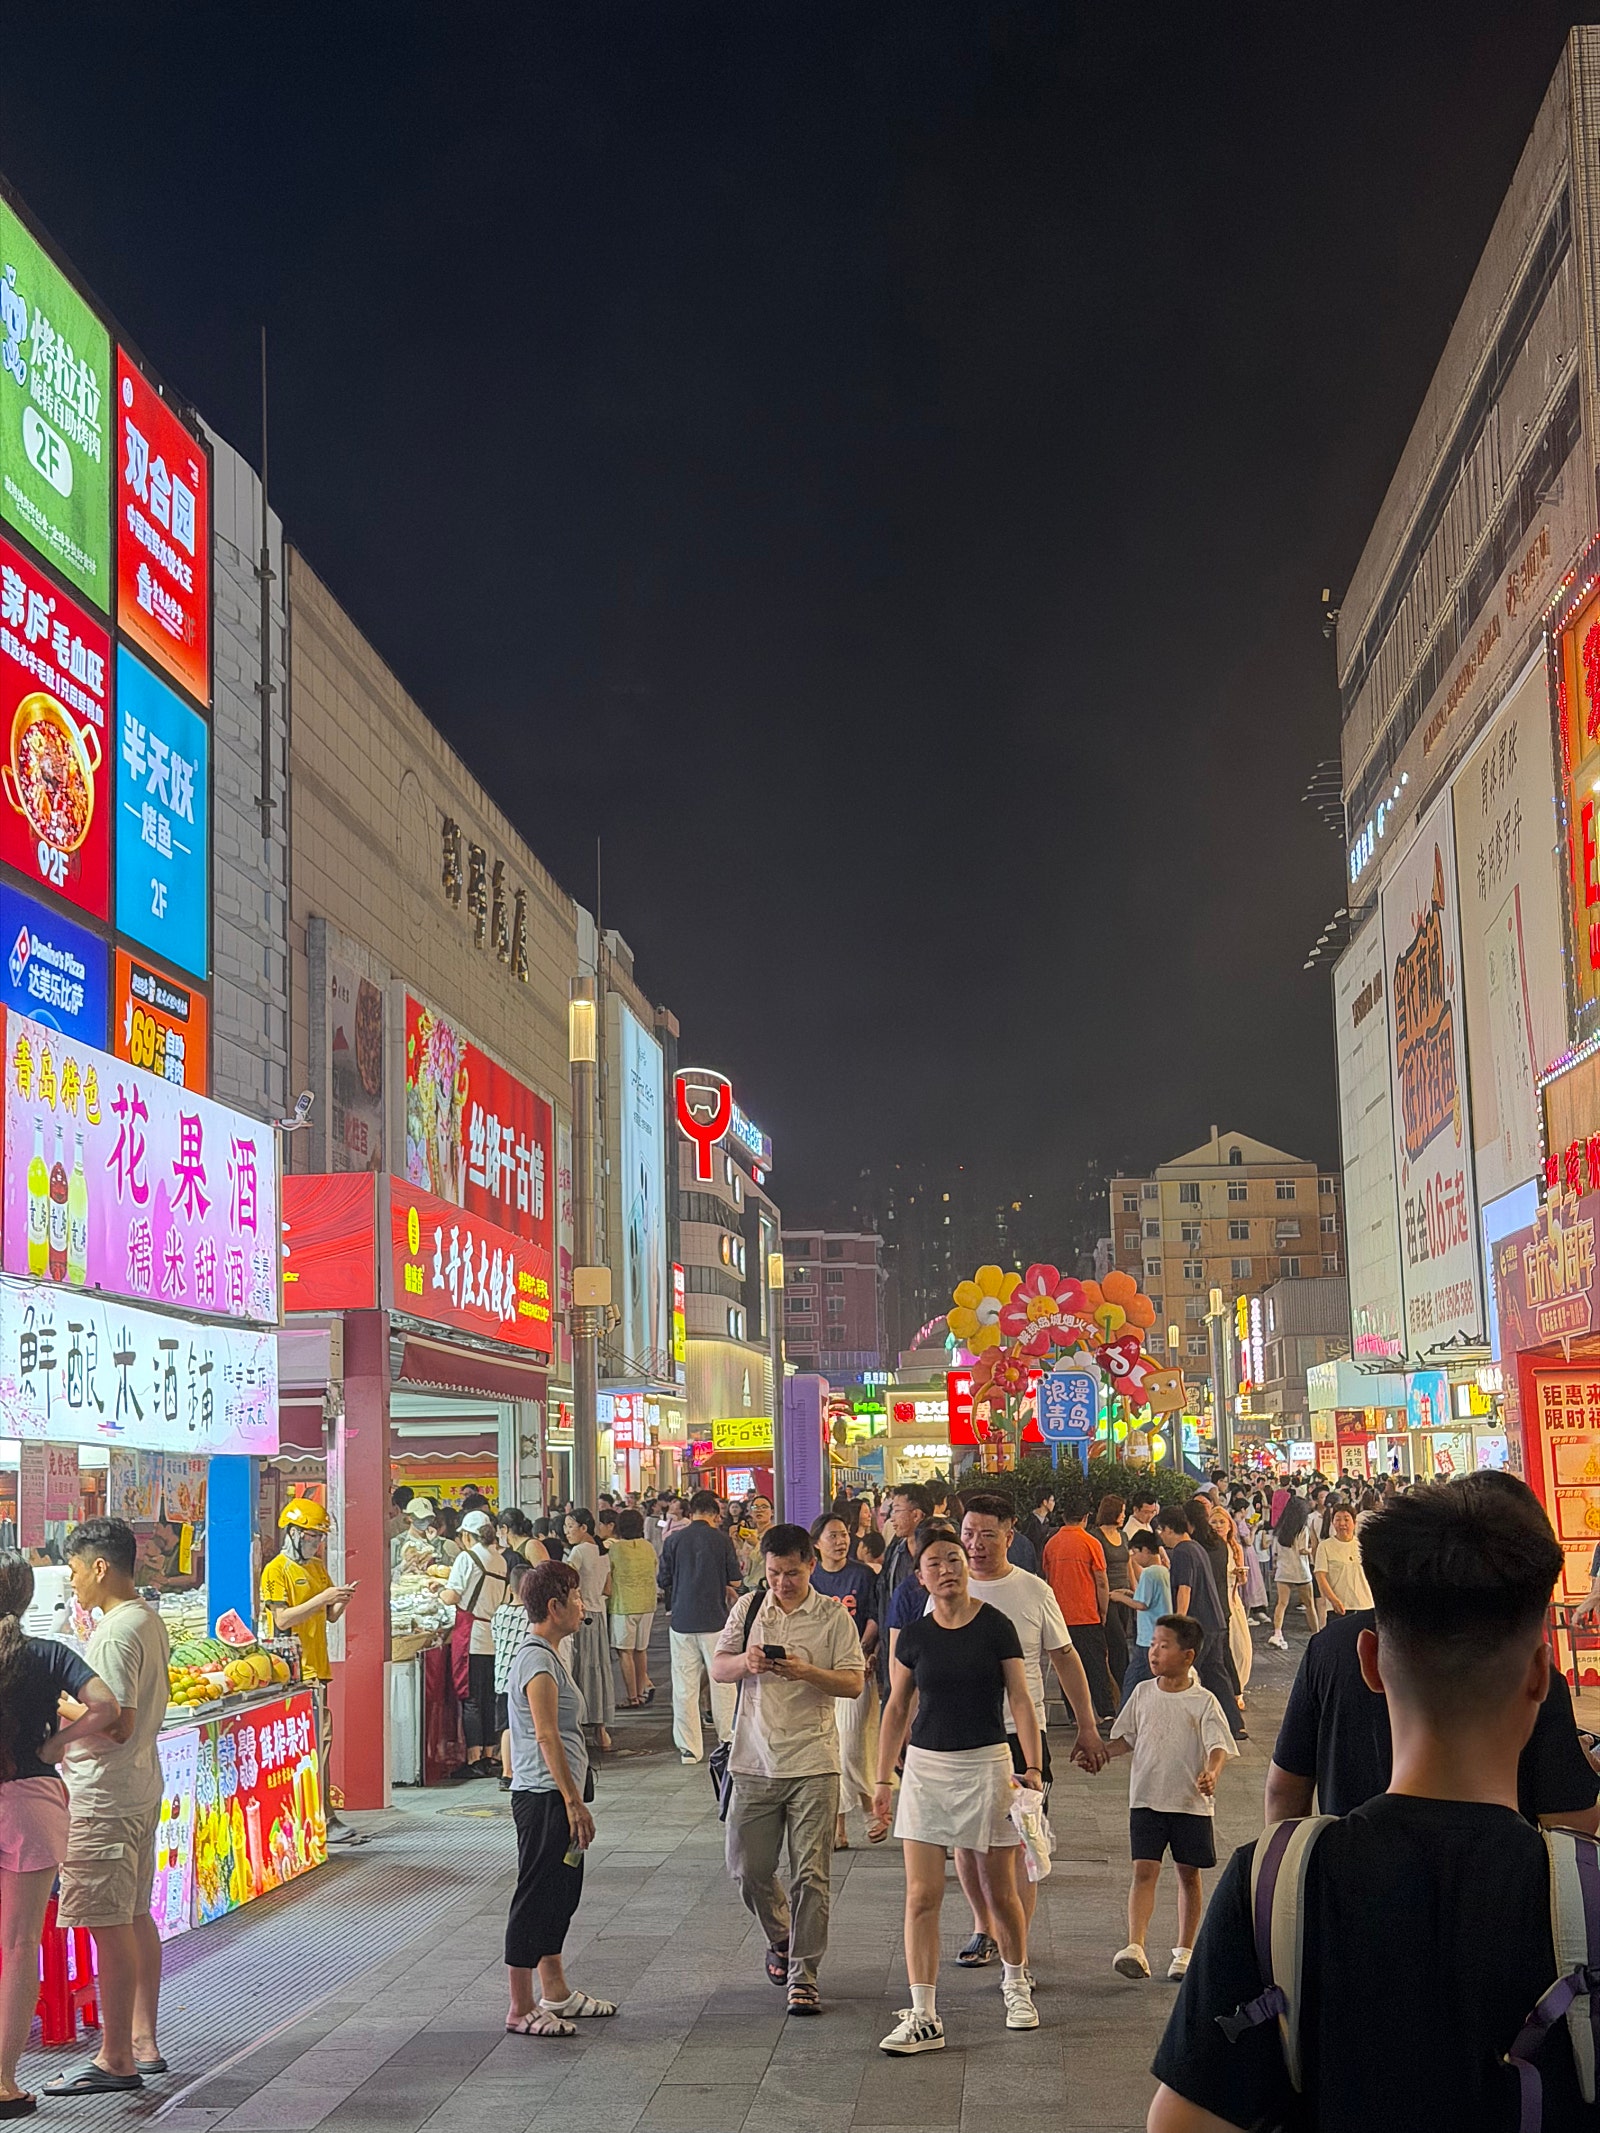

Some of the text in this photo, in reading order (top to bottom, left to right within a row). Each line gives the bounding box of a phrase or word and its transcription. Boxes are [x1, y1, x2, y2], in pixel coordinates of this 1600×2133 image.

[30, 306, 102, 432] 烤拉拉
[30, 367, 101, 463] 旋转自助烤肉
[34, 419, 60, 479] 2F
[125, 416, 195, 556] 双合园
[1, 565, 105, 698] 茅庐 毛血旺
[122, 711, 195, 825] 半天妖
[49, 848, 69, 887] 2F
[141, 801, 173, 859] 烤鱼
[151, 878, 168, 919] 2F
[28, 963, 84, 1016] 达美乐比萨
[31, 934, 85, 980] Domino's Pizza
[1395, 928, 1443, 1042] 当代商城
[13, 1032, 101, 1126] 青岛特色
[131, 1006, 157, 1068] 69
[1403, 1025, 1454, 1141] 低价招租
[106, 1082, 259, 1240] 花果酒
[469, 1101, 544, 1221] 丝路千古情
[126, 1216, 245, 1315] 糯米甜酒
[1405, 1169, 1469, 1268] 租金0.6元起
[432, 1225, 516, 1322] 王哥庄大馒头
[20, 1305, 214, 1433] 鲜酿米酒铺
[1017, 1313, 1099, 1346] 解锁岛城烟火气
[1045, 1379, 1090, 1405] 浪漫
[1045, 1403, 1090, 1432] 青岛
[260, 1711, 310, 1769] 鲜榨果汁
